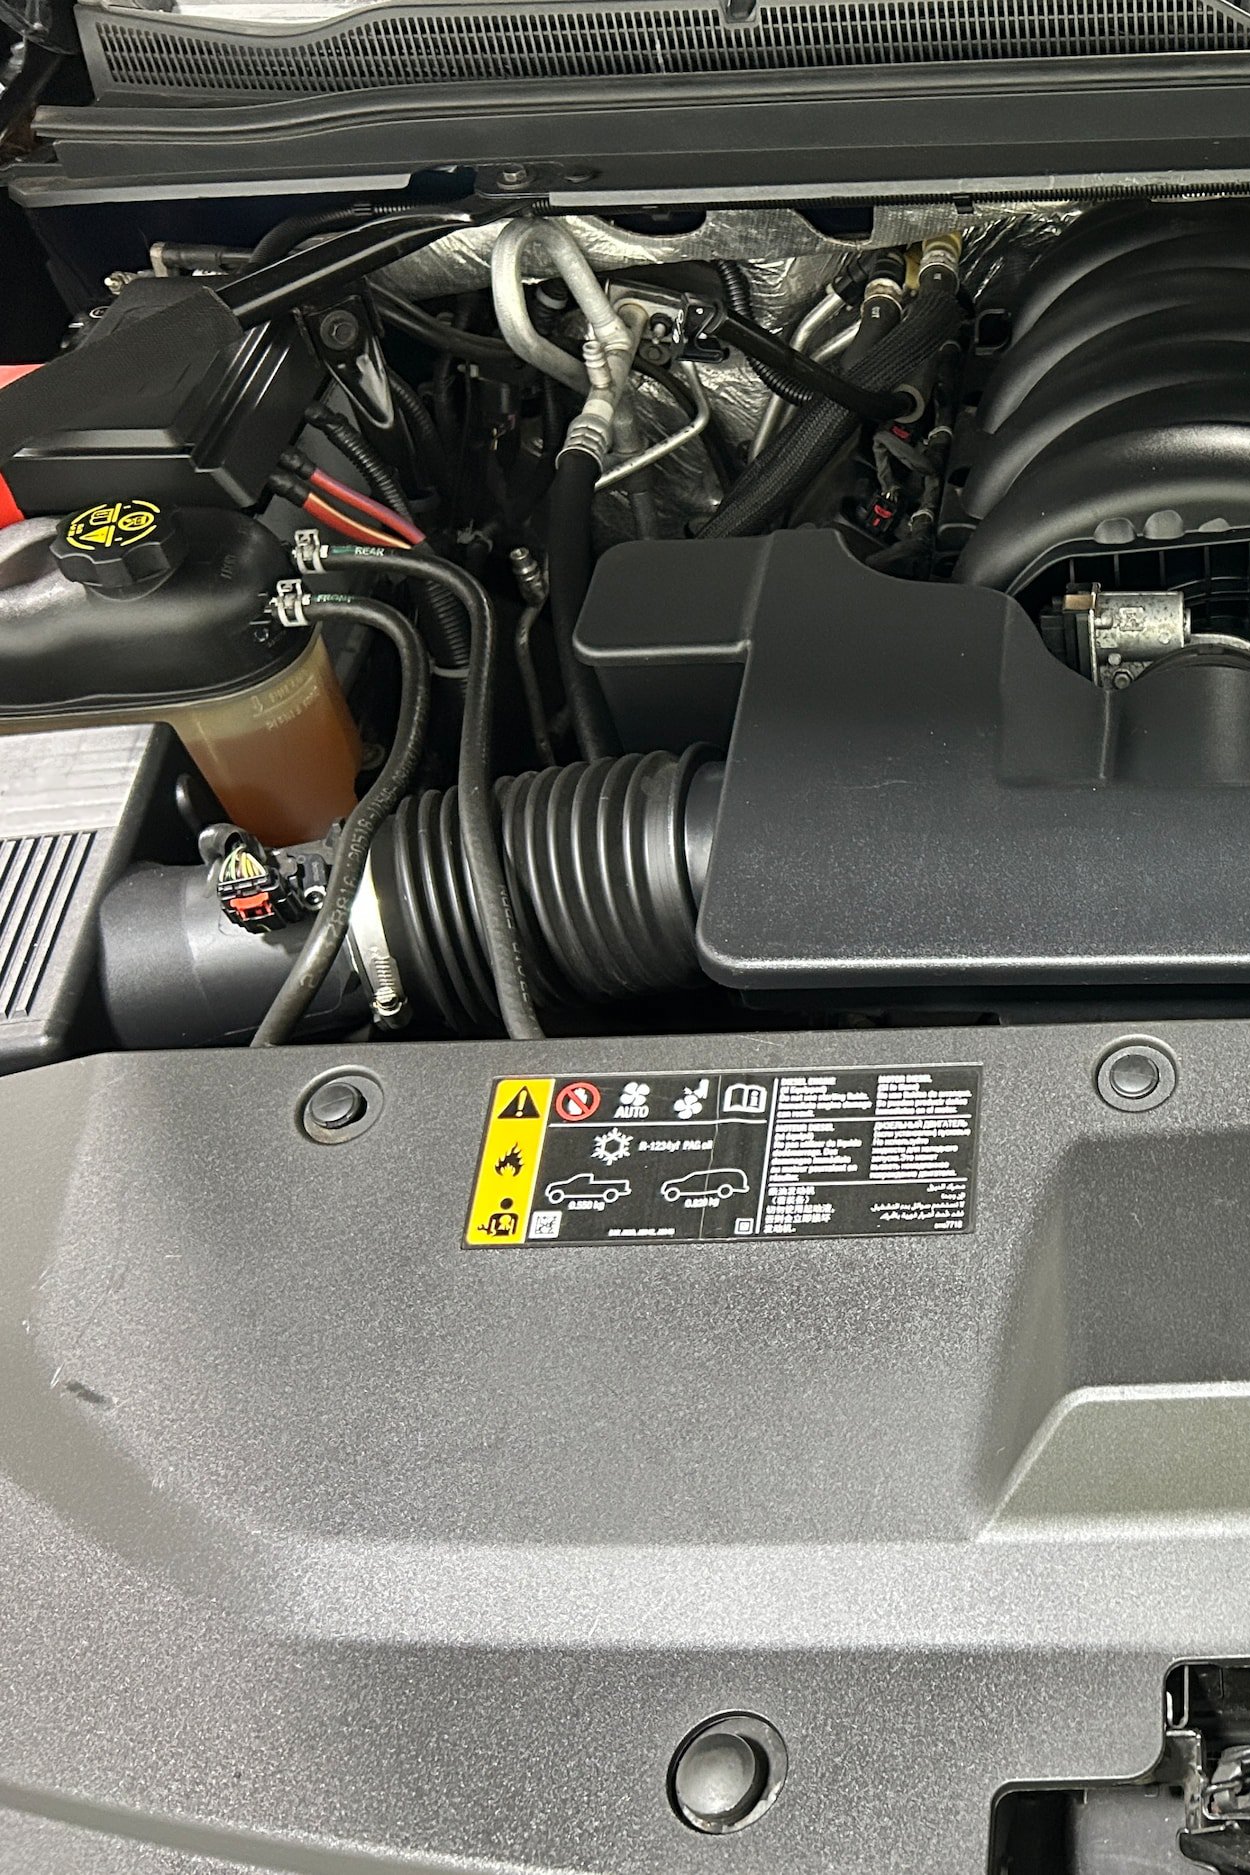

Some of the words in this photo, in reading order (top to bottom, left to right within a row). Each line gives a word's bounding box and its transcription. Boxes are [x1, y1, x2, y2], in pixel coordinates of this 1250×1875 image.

[354, 546, 385, 557] REAR
[316, 593, 352, 603] FRONT
[614, 1106, 649, 1118] AUTO
[683, 1140, 701, 1150] PAG
[593, 1201, 605, 1210] kg
[709, 1198, 719, 1207] kg
